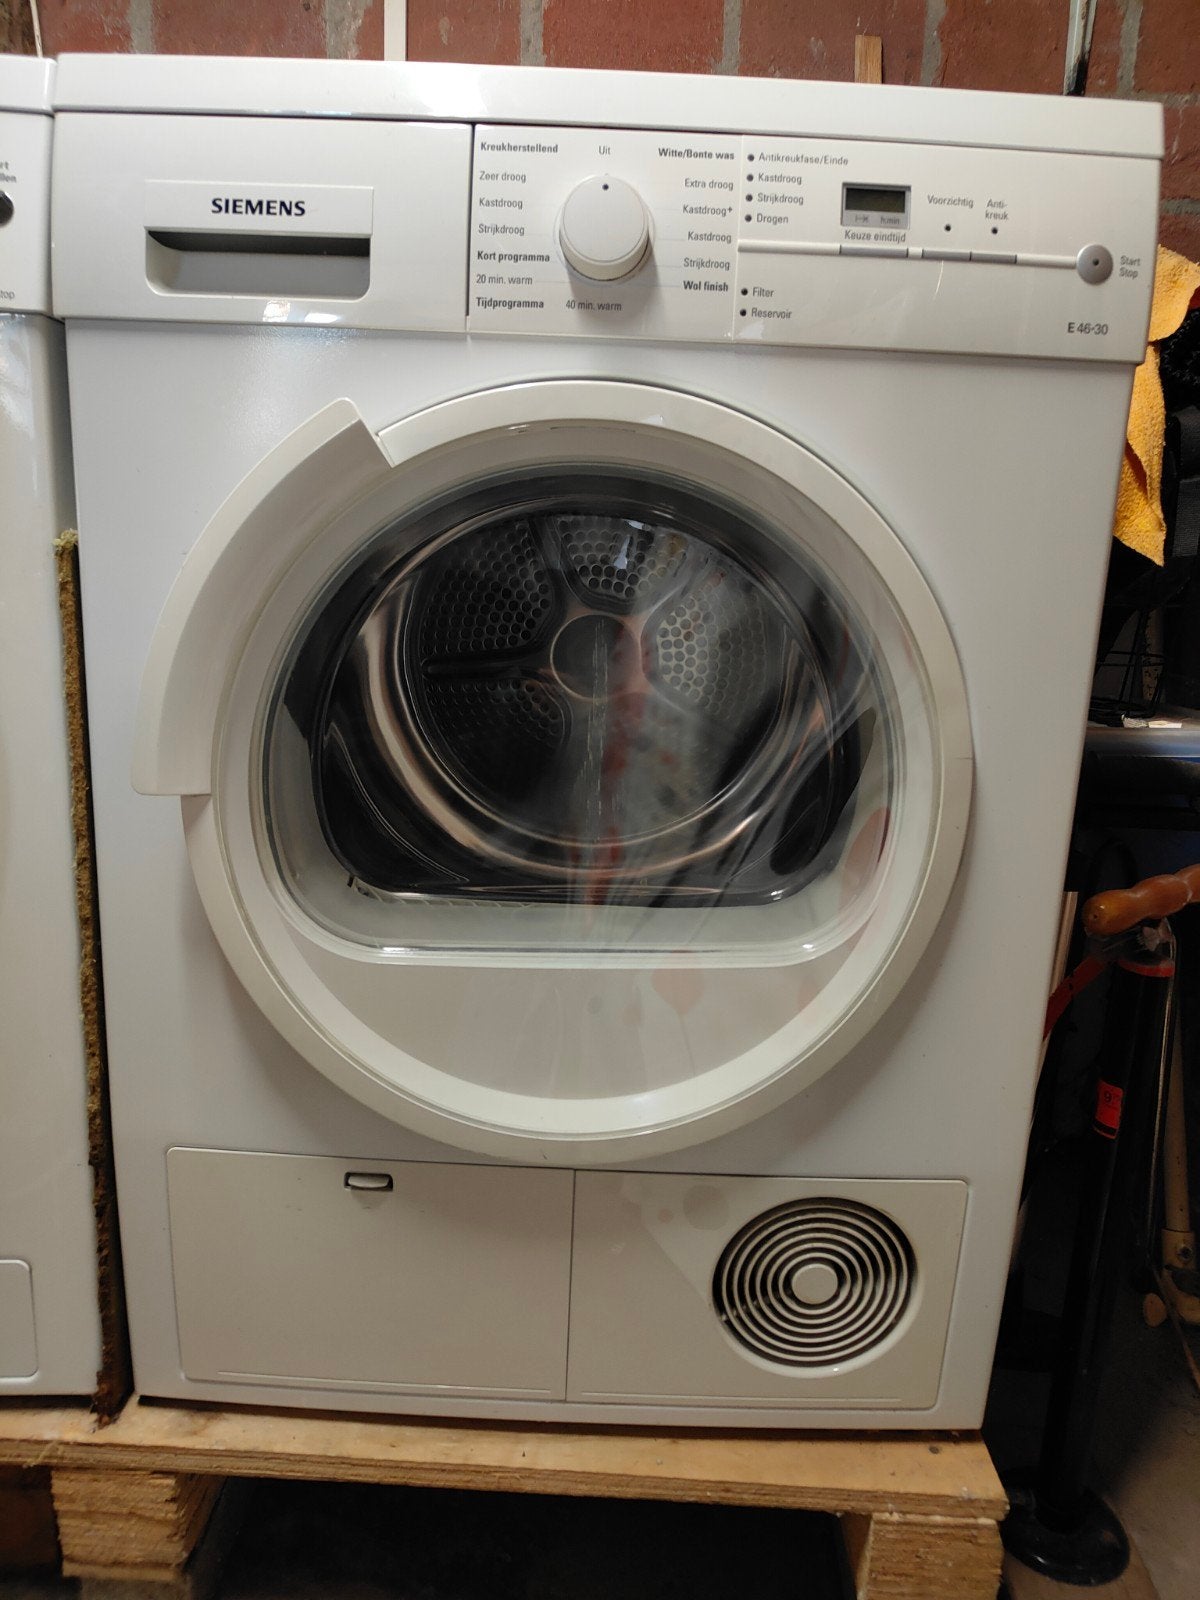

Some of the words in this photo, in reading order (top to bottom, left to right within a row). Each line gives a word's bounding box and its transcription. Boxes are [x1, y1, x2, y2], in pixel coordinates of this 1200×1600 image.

[480, 142, 559, 153] Kreukherstellend
[598, 145, 611, 155] Uit
[658, 147, 713, 159] Witte/Bonte
[715, 152, 735, 160] was
[758, 152, 849, 166] Antikreukfase/Einde
[479, 170, 499, 180] Zeer
[501, 172, 527, 184] droog
[758, 173, 803, 185] Kastdroog
[684, 178, 707, 189] Extra
[708, 180, 734, 192] droog
[479, 197, 523, 210] Kastdroog
[757, 193, 804, 206] Strijkdroog
[927, 194, 975, 209] Voorzichtig
[211, 197, 306, 217] SIEMENS
[756, 213, 789, 225] Drogen
[478, 223, 525, 237] Strijkdroog
[687, 231, 732, 244] Kastdroog
[844, 230, 872, 241] Keuze
[873, 232, 907, 244] eindtijd
[477, 250, 496, 261] Kort
[498, 252, 551, 264] programma
[1120, 255, 1141, 266] Start
[683, 257, 730, 271] Strijkdroog
[476, 274, 487, 284] 20
[488, 274, 507, 284] min.
[1119, 267, 1139, 279] Stop
[683, 280, 702, 291] Wol
[703, 281, 729, 292] finish
[752, 286, 775, 298] Filter
[476, 297, 545, 309] Tijdprogramma
[565, 300, 576, 309] 40
[577, 300, 596, 311] min.
[597, 303, 622, 311] warm
[751, 307, 792, 319] Reservoir
[1067, 322, 1076, 333] E
